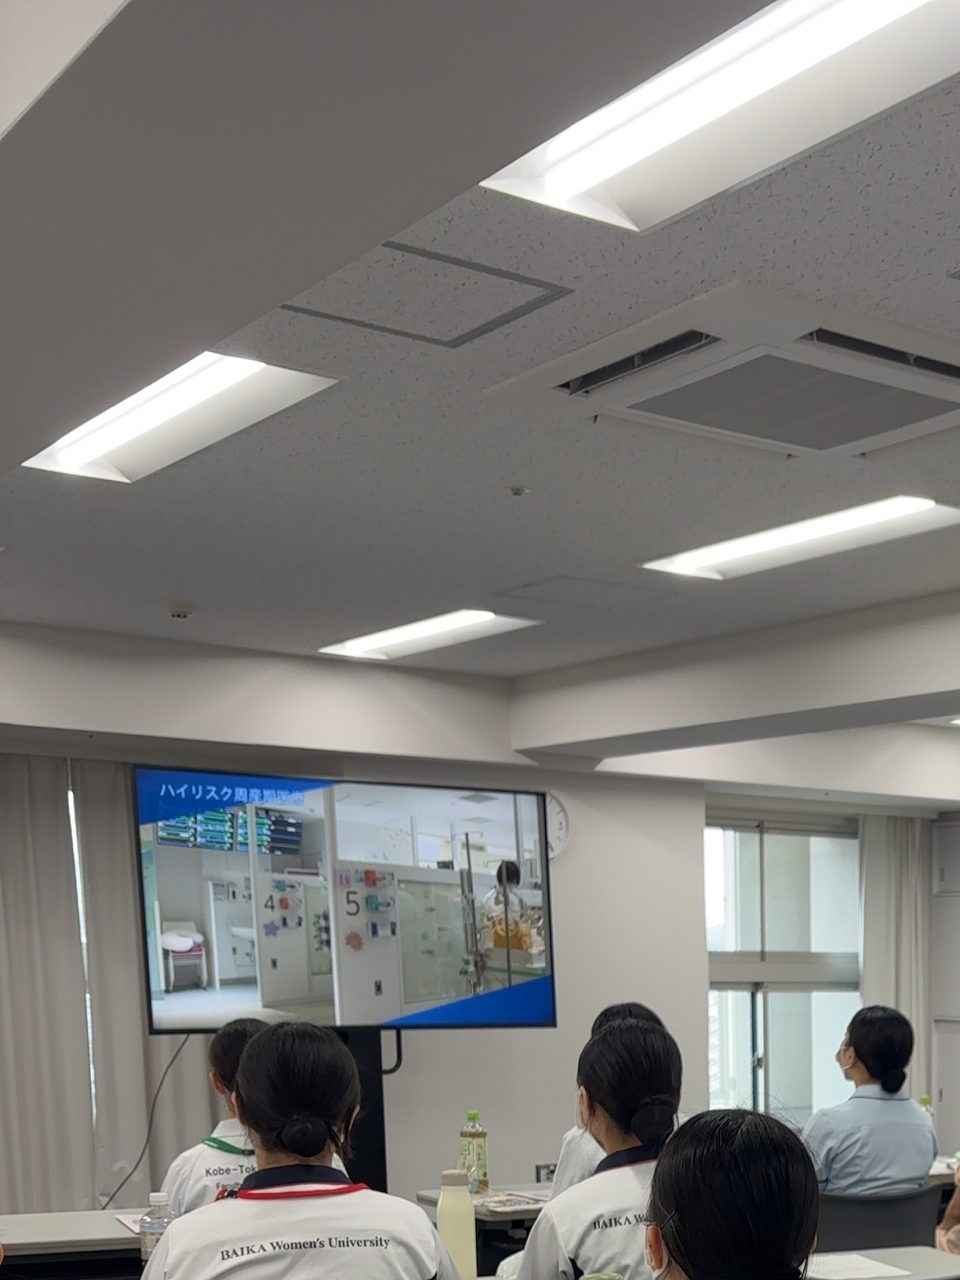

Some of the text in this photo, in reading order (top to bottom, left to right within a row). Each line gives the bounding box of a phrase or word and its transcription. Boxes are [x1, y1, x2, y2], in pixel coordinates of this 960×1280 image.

[264, 894, 275, 912] 4
[346, 890, 361, 916] 5
[592, 1216, 632, 1230] BAIKA
[220, 1236, 391, 1261] BAIKA Women's University
